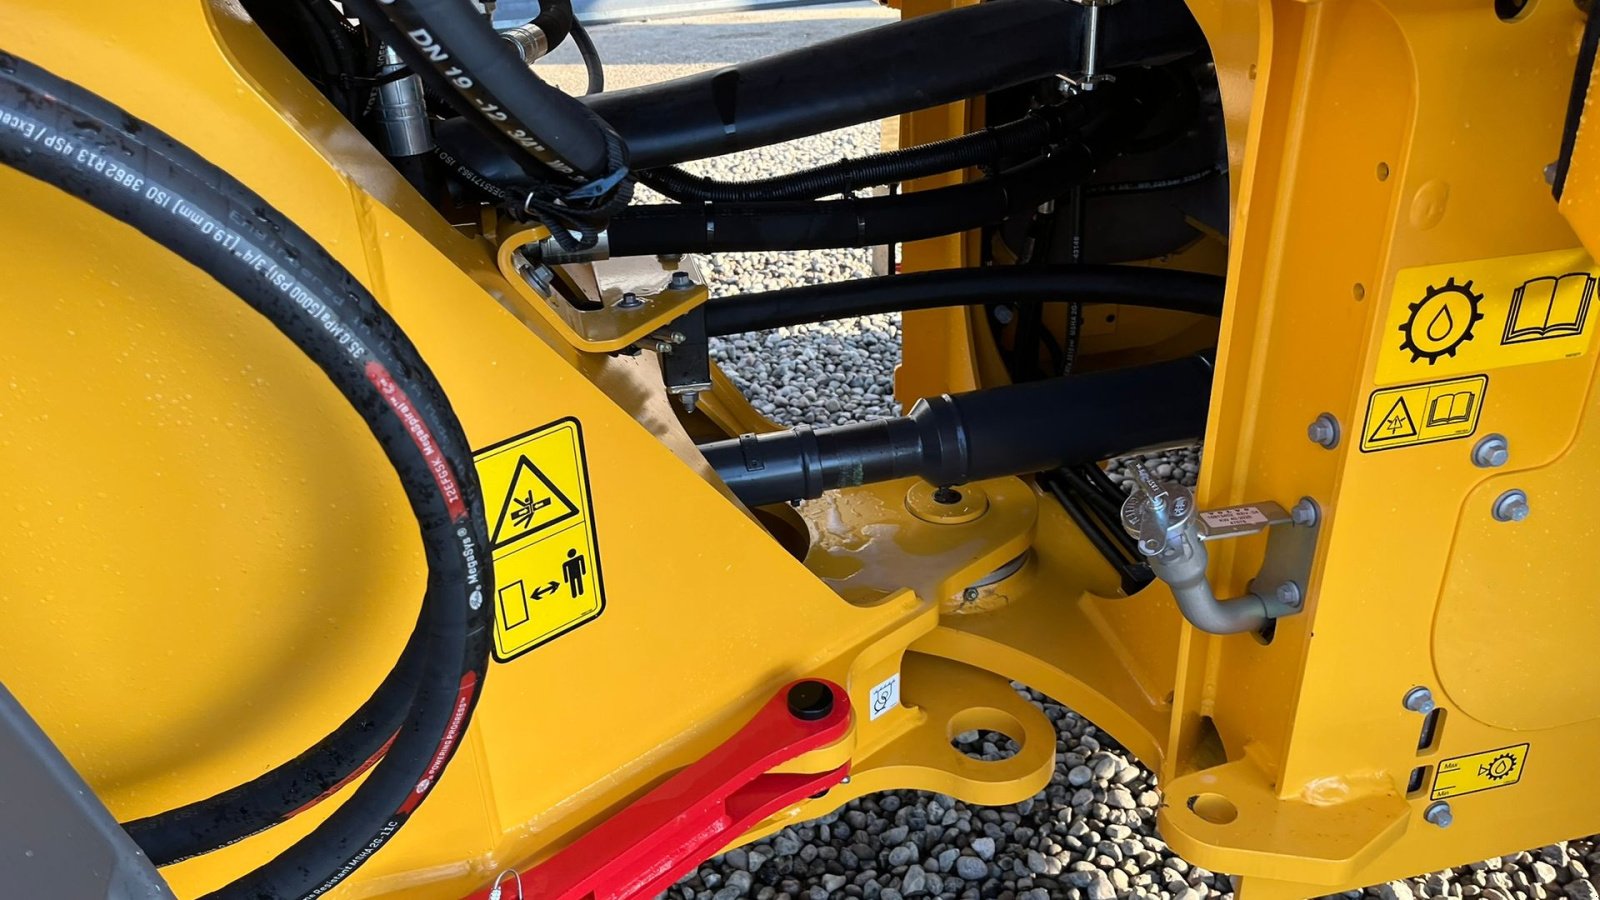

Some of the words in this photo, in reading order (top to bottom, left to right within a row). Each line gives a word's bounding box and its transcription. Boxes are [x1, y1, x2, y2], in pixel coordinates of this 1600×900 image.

[407, 28, 449, 62] DN
[445, 66, 474, 89] 19
[475, 98, 508, 122] -12
[44, 135, 76, 156] 4SP
[77, 149, 107, 172] R13
[105, 163, 145, 192] 3862
[145, 186, 170, 207] ISO
[320, 312, 340, 336] MPa
[339, 332, 365, 358] 35.0
